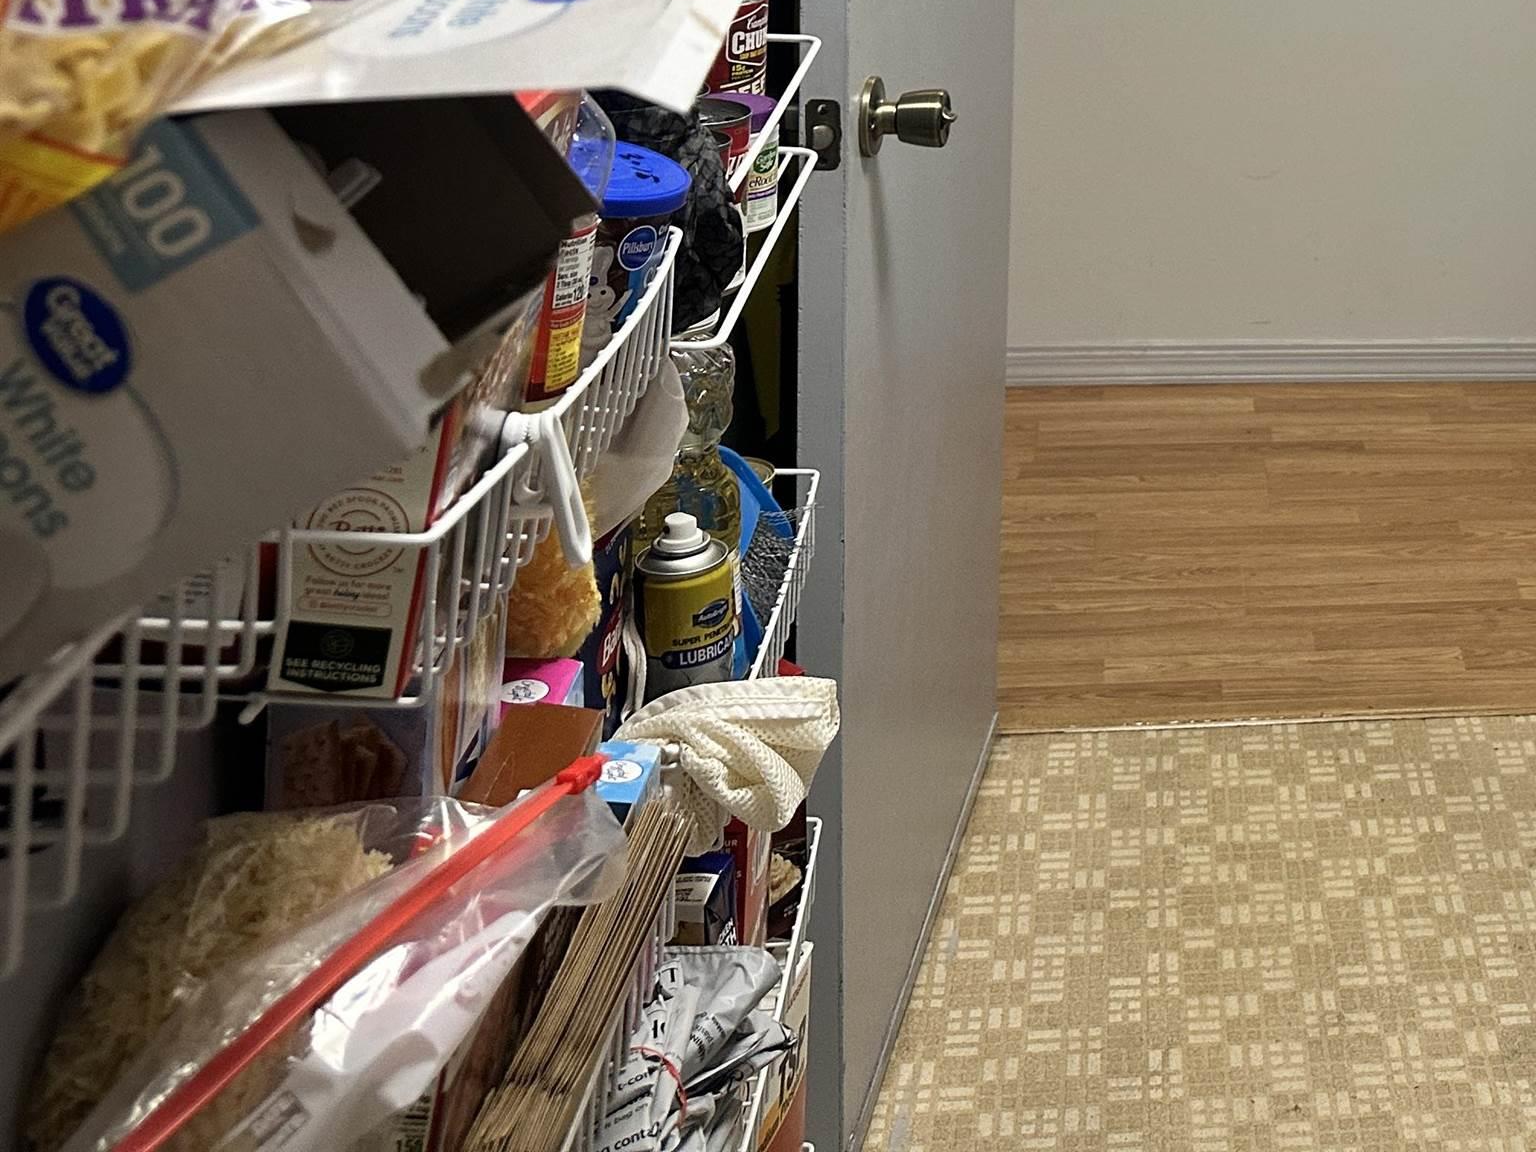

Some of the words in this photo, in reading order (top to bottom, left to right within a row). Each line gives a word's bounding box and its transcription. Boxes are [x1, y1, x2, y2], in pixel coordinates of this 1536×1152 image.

[110, 143, 213, 257] 100
[672, 635, 701, 646] SUPER
[286, 658, 308, 667] SEE
[311, 660, 381, 673] RECYCLING
[286, 668, 377, 683] INSTRUCTIONS
